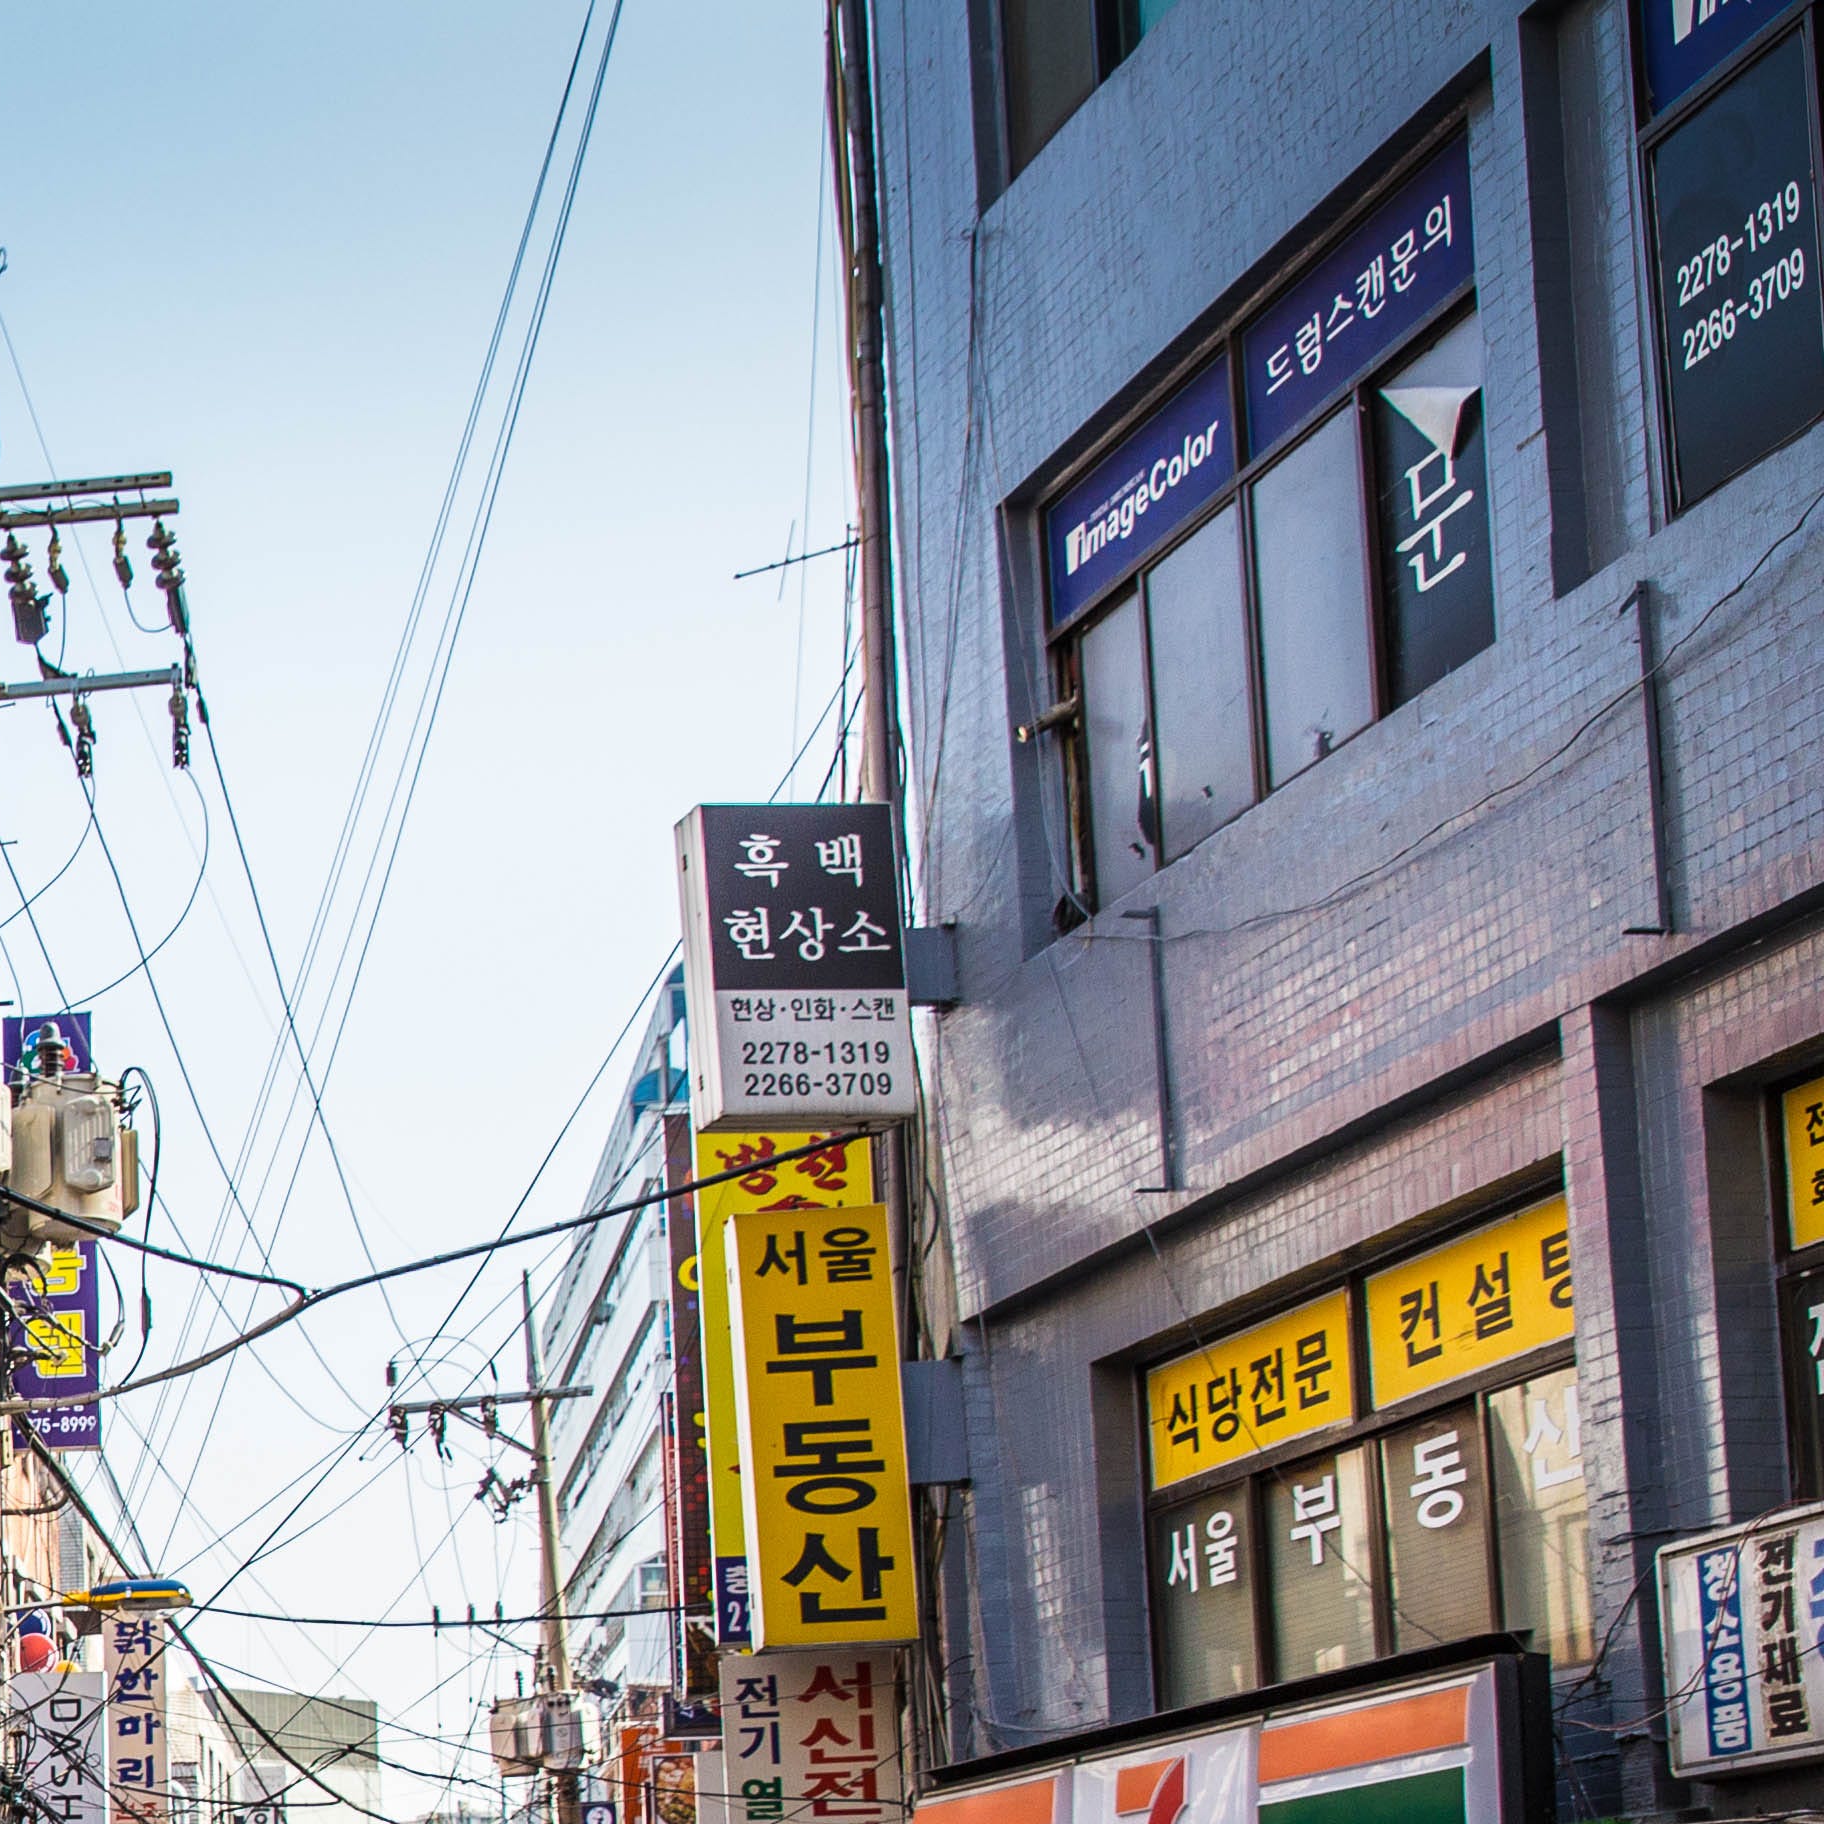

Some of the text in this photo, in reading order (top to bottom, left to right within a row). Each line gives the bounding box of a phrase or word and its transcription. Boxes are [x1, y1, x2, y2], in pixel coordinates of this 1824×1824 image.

[1267, 196, 1453, 395] 드럼스캔문의
[1676, 181, 1801, 307] 2278-1319
[1683, 250, 1807, 371] 2266-3709
[722, 906, 892, 962] 현상소
[741, 1040, 891, 1066] 2278-1319
[744, 1072, 893, 1097] 2266-3709
[755, 1227, 878, 1287] 서울
[1165, 1328, 1334, 1455] 식당전문
[765, 1309, 896, 1625] 부동산
[1166, 1511, 1237, 1594] 서울
[1757, 1532, 1811, 1742] 전기재료
